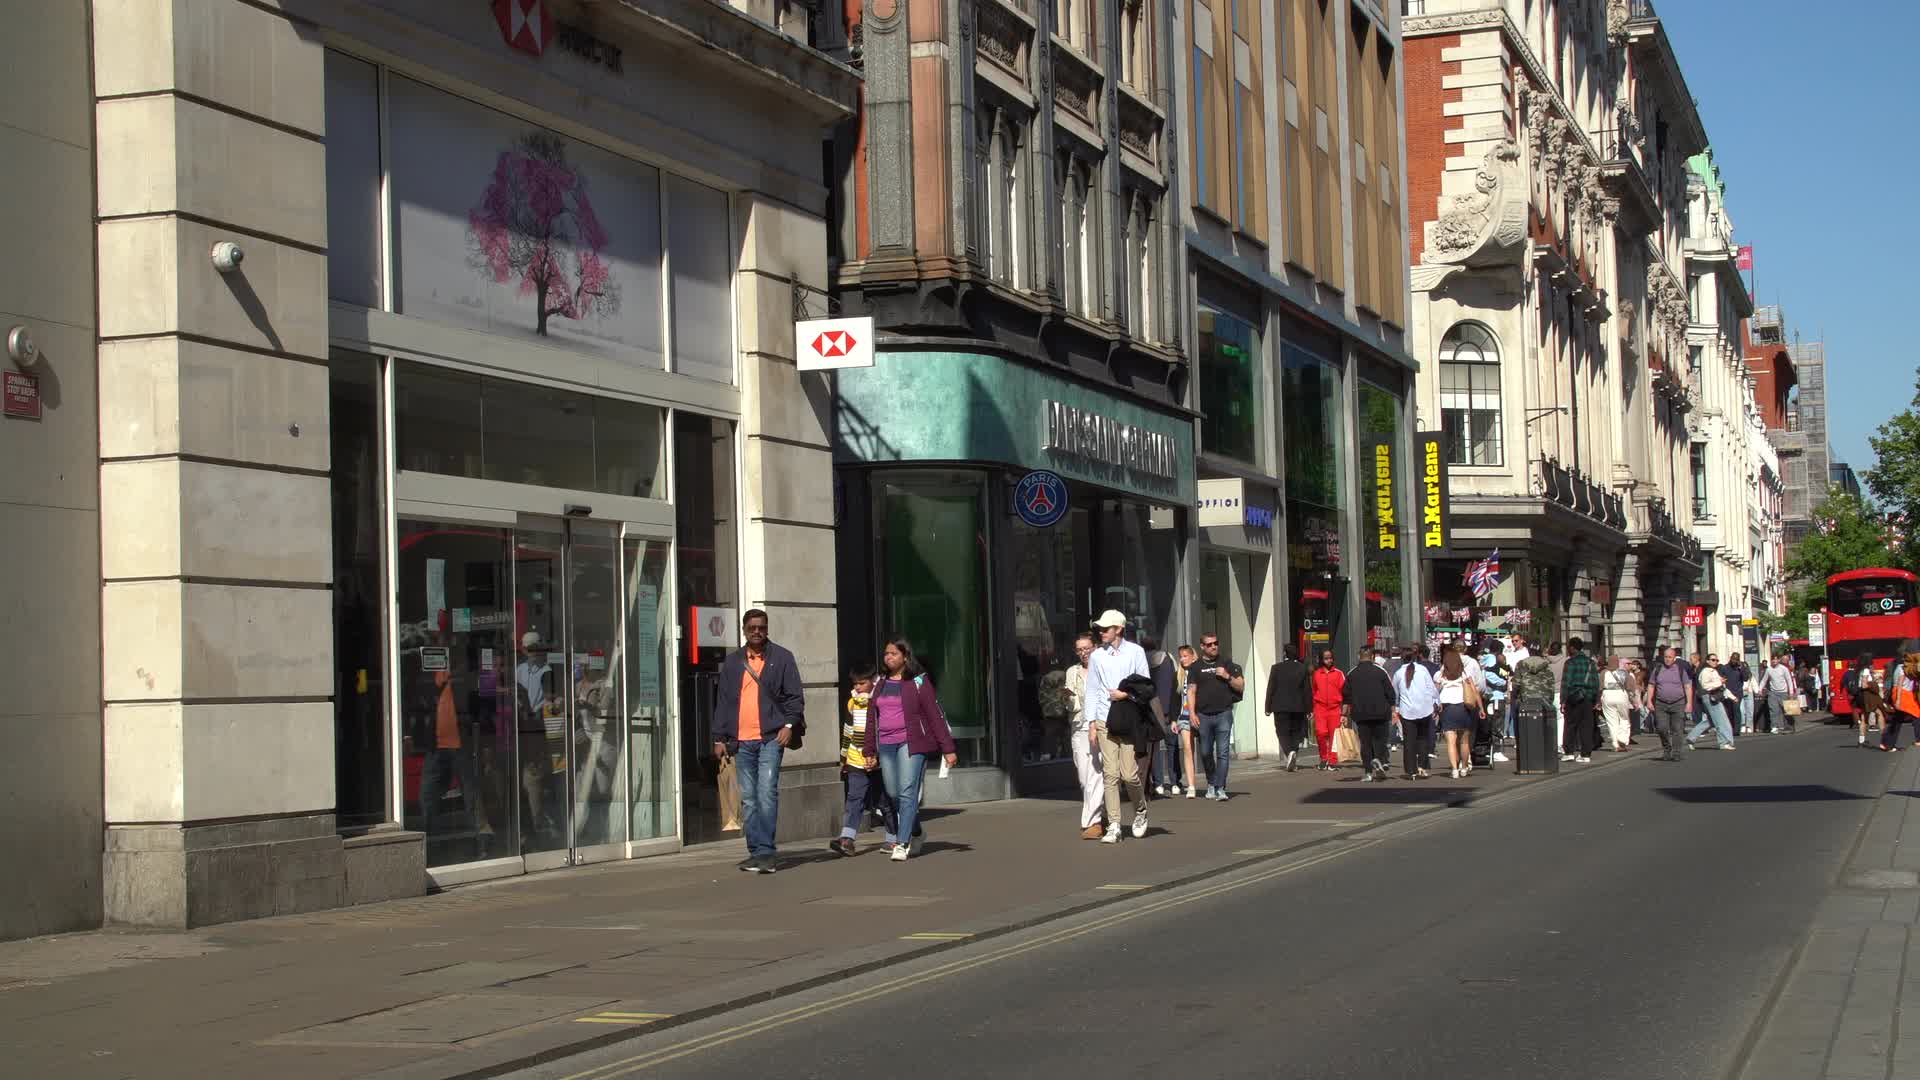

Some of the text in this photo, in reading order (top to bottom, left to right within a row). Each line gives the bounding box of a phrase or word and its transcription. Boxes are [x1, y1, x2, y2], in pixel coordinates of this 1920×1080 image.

[1024, 474, 1057, 487] PARIS
[1864, 602, 1879, 613] 98
[1685, 616, 1700, 624] QLO
